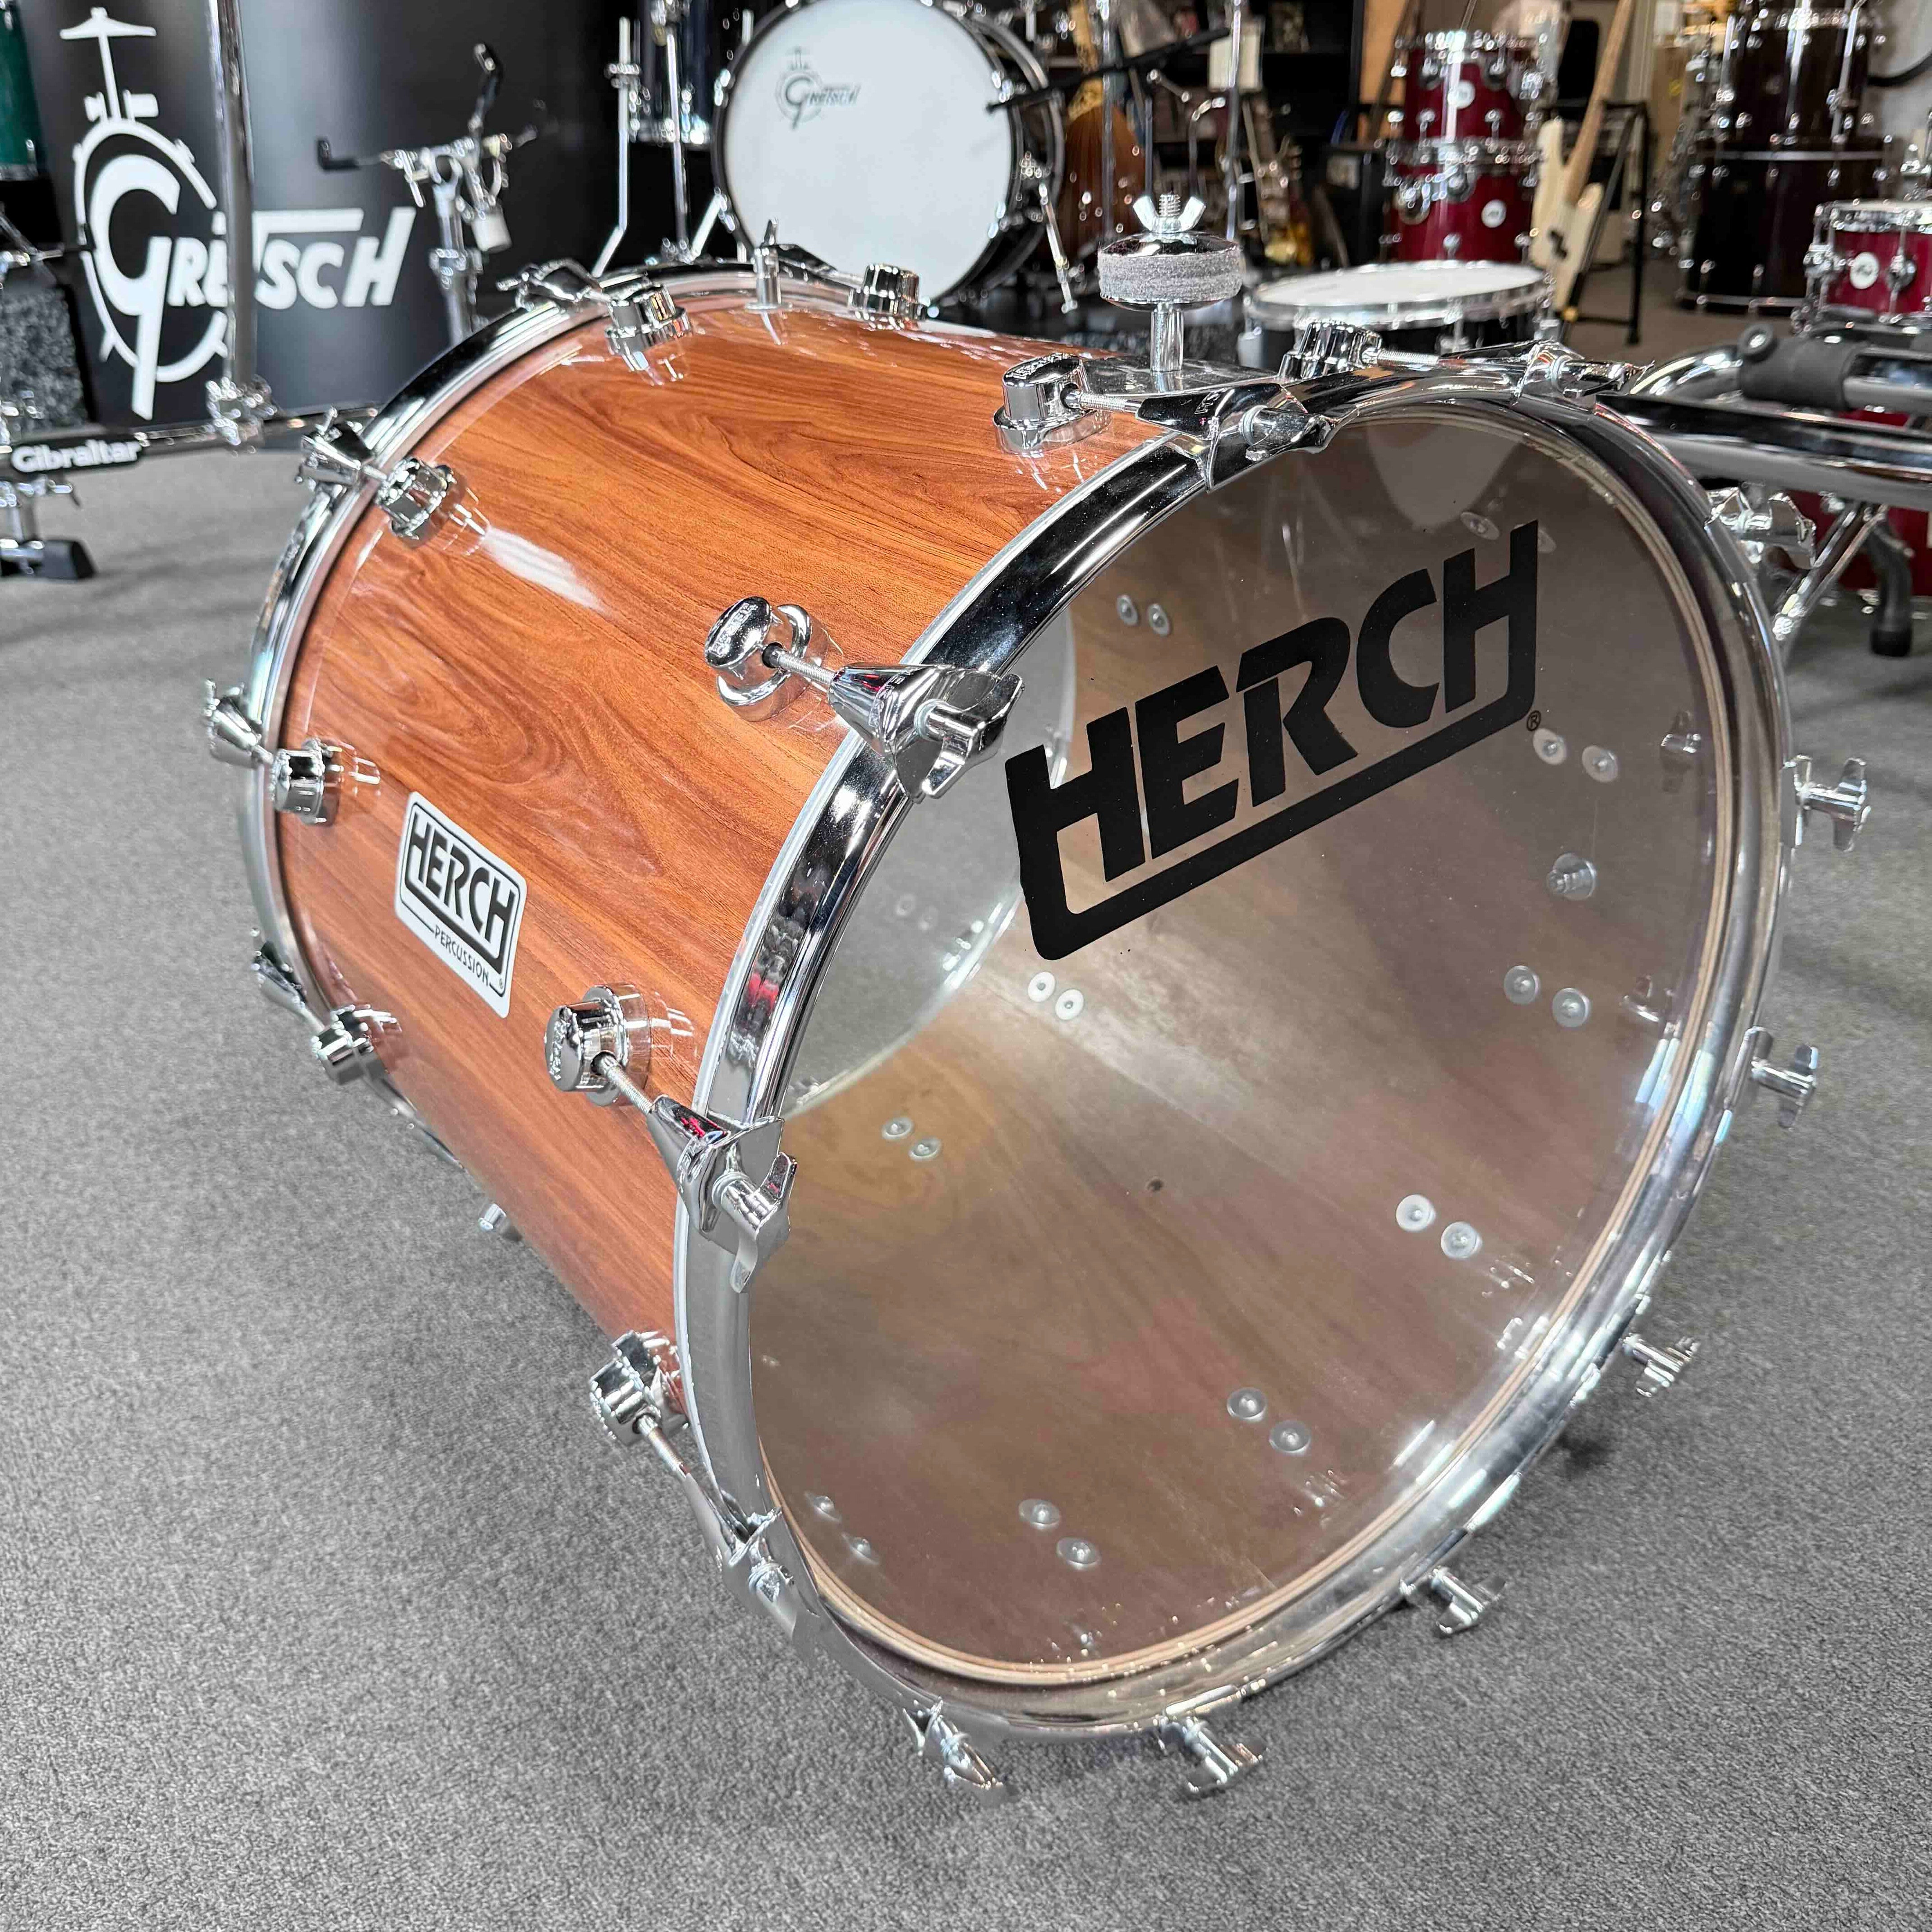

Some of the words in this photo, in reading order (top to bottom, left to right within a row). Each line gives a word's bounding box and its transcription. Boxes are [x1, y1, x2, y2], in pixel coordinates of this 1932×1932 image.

[11, 439, 142, 472] Gibraltar
[1005, 520, 1538, 960] HERCH
[405, 812, 516, 975] HERCH
[434, 925, 489, 987] PERCUSSION
